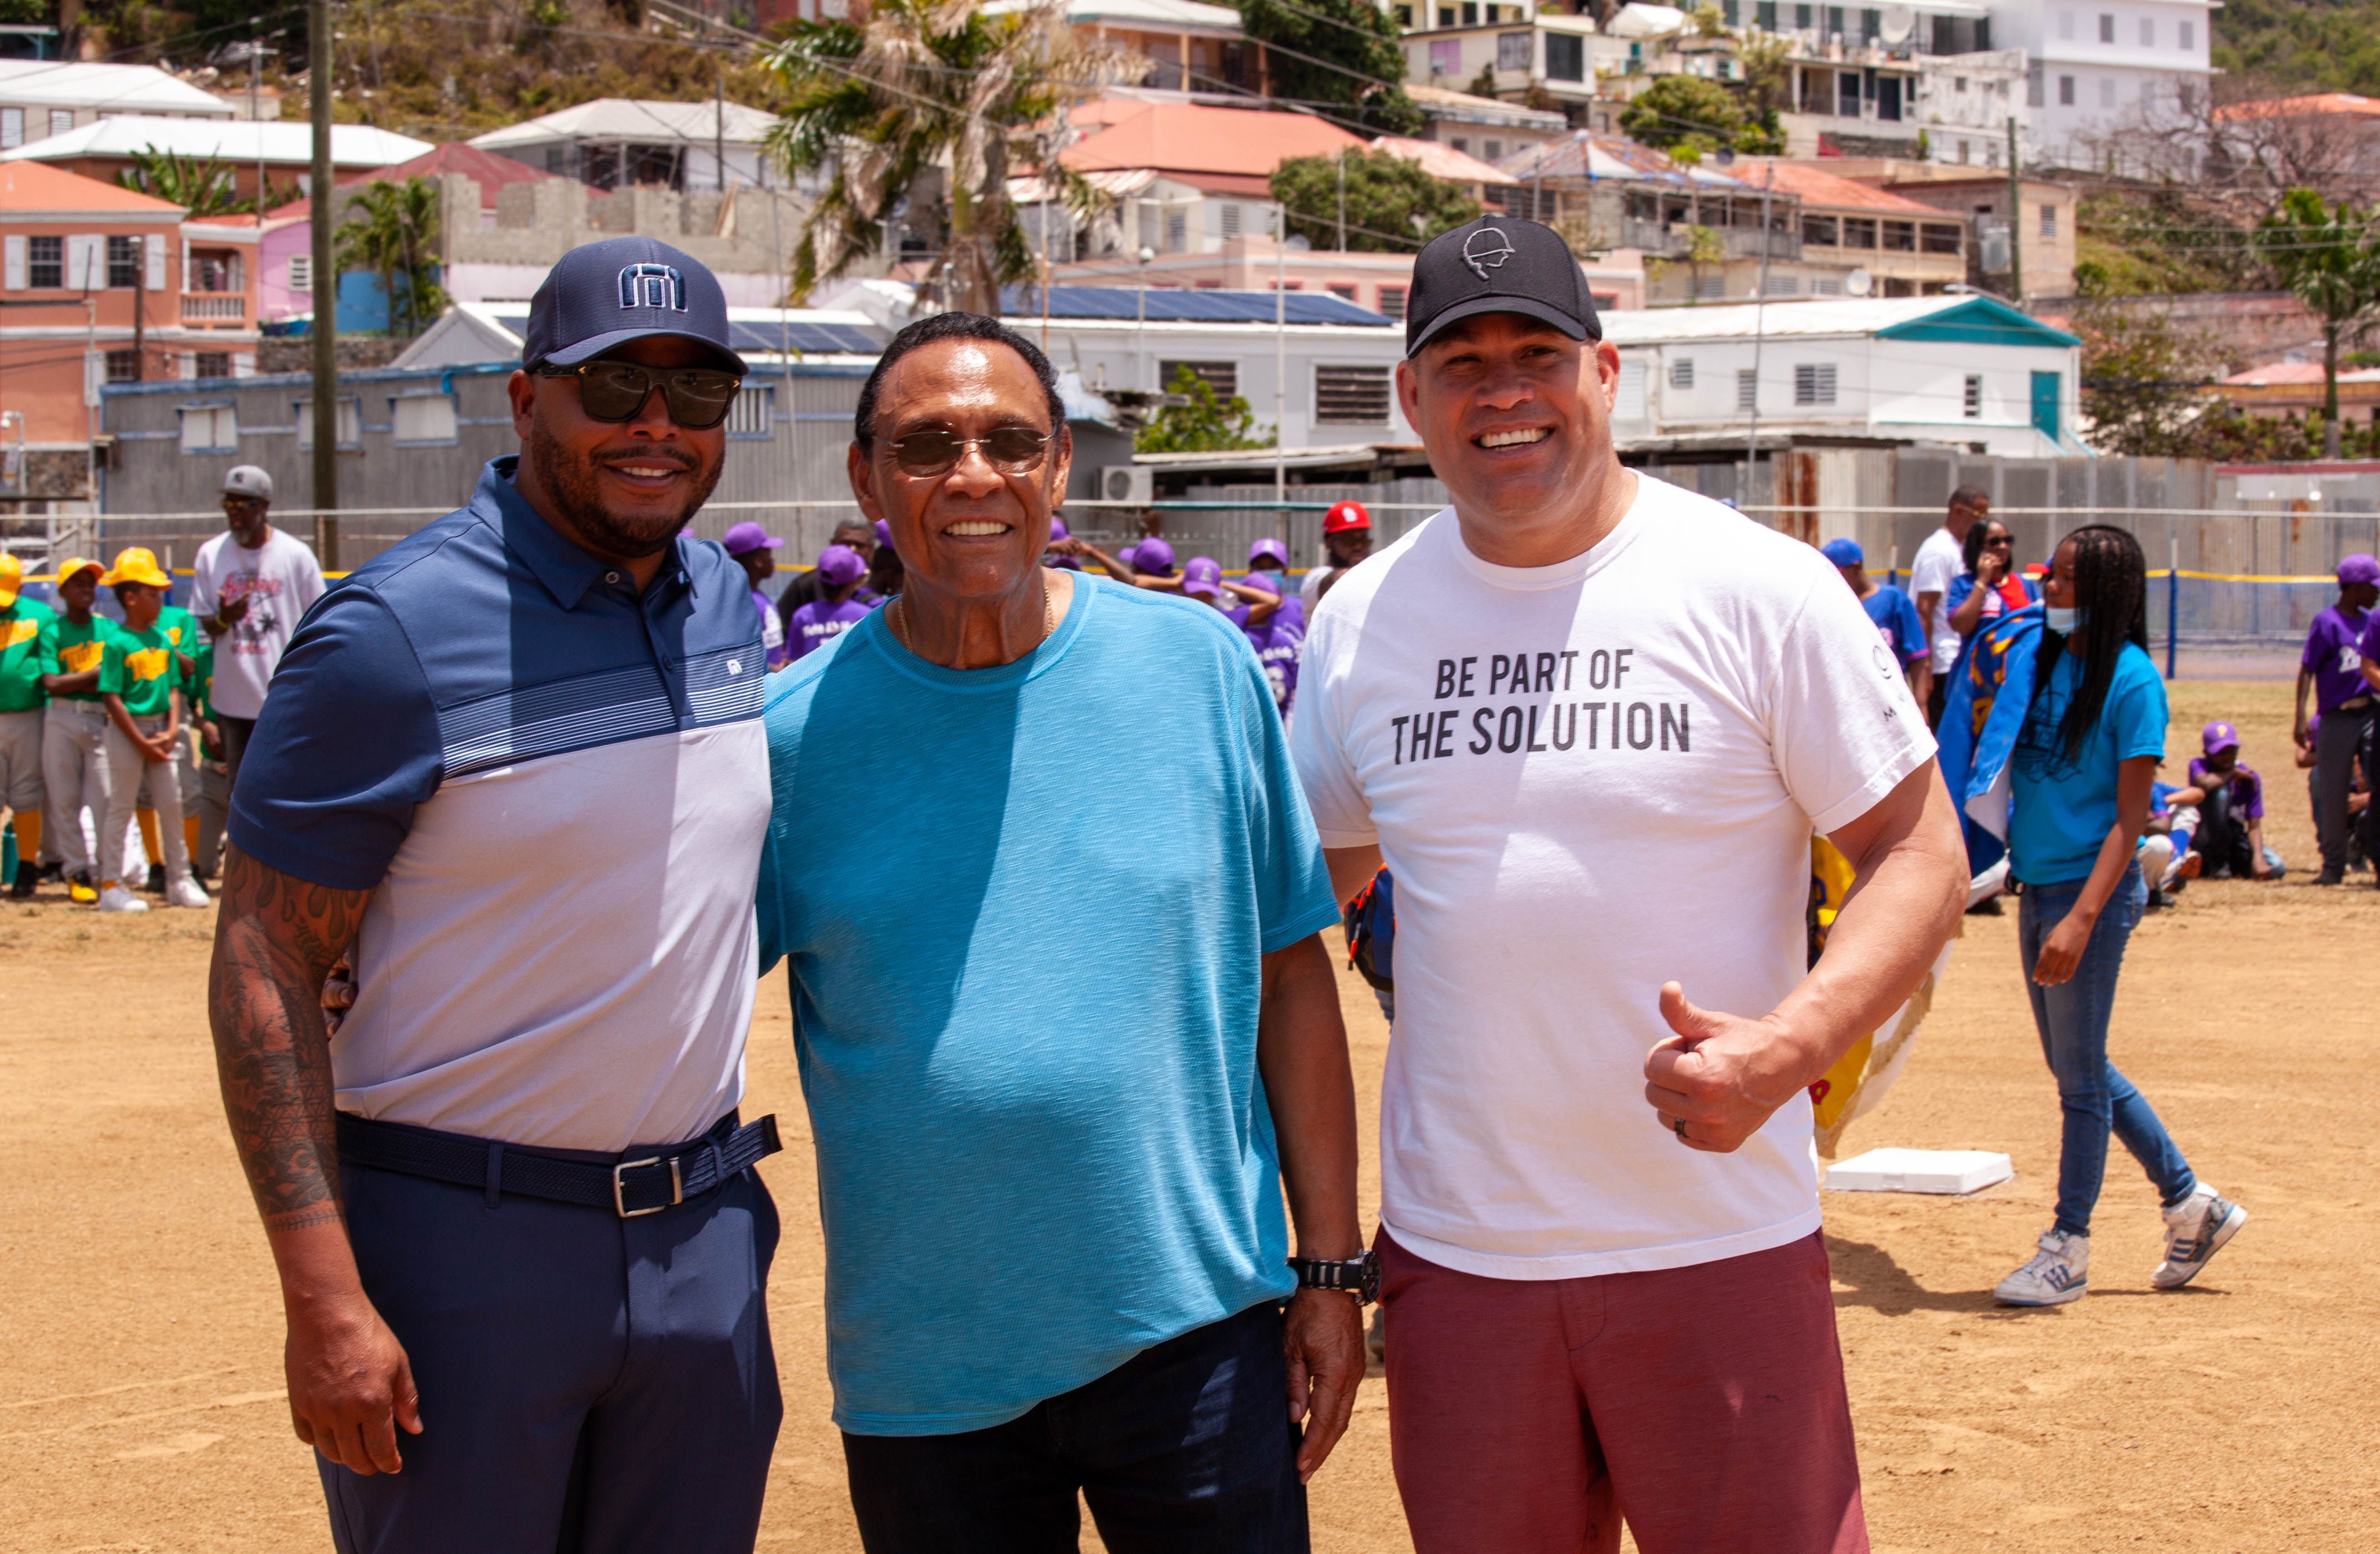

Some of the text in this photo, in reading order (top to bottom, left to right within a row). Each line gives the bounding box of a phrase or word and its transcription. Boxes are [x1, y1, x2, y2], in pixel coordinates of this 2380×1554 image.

[1434, 649, 1633, 699] BE PART OF
[1392, 702, 1690, 765] THE SOLUTION
